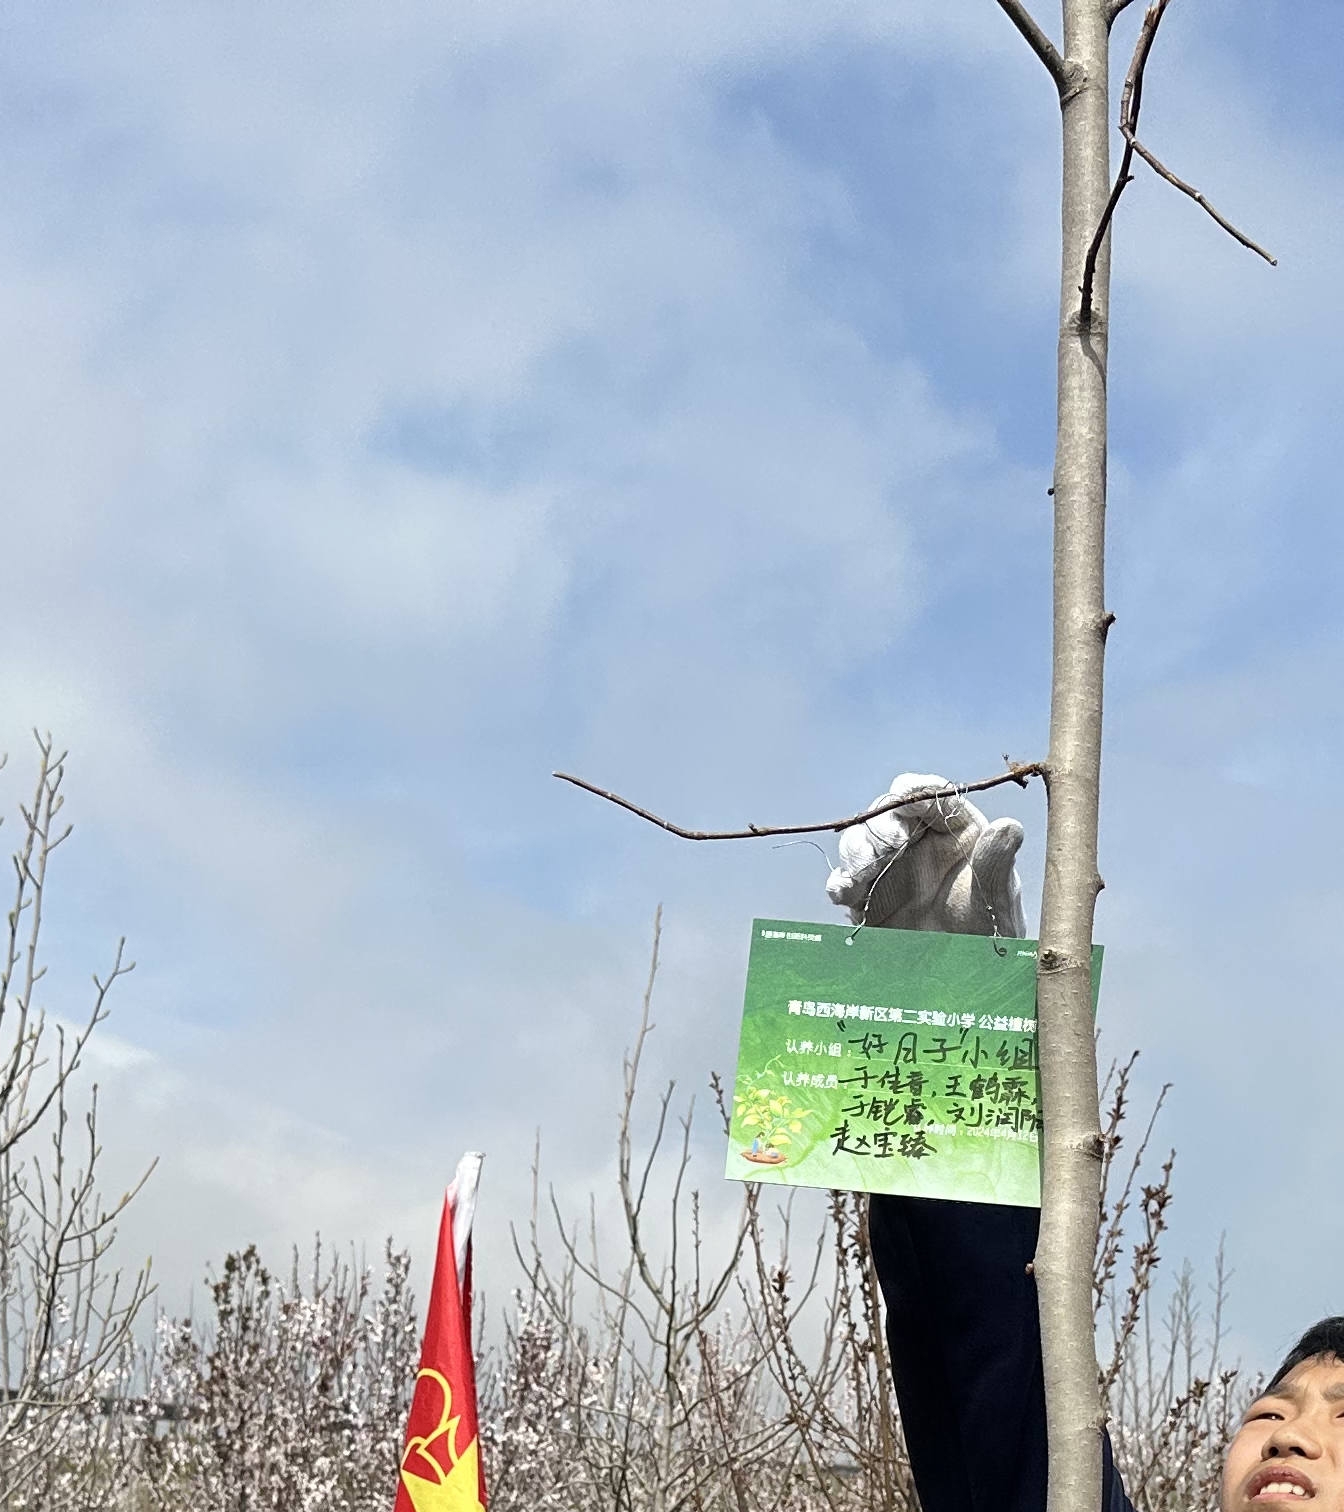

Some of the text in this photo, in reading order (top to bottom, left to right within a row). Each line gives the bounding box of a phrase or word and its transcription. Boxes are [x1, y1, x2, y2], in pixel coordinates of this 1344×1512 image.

[787, 999, 976, 1028] 青岛西海岸新区第二实验小学
